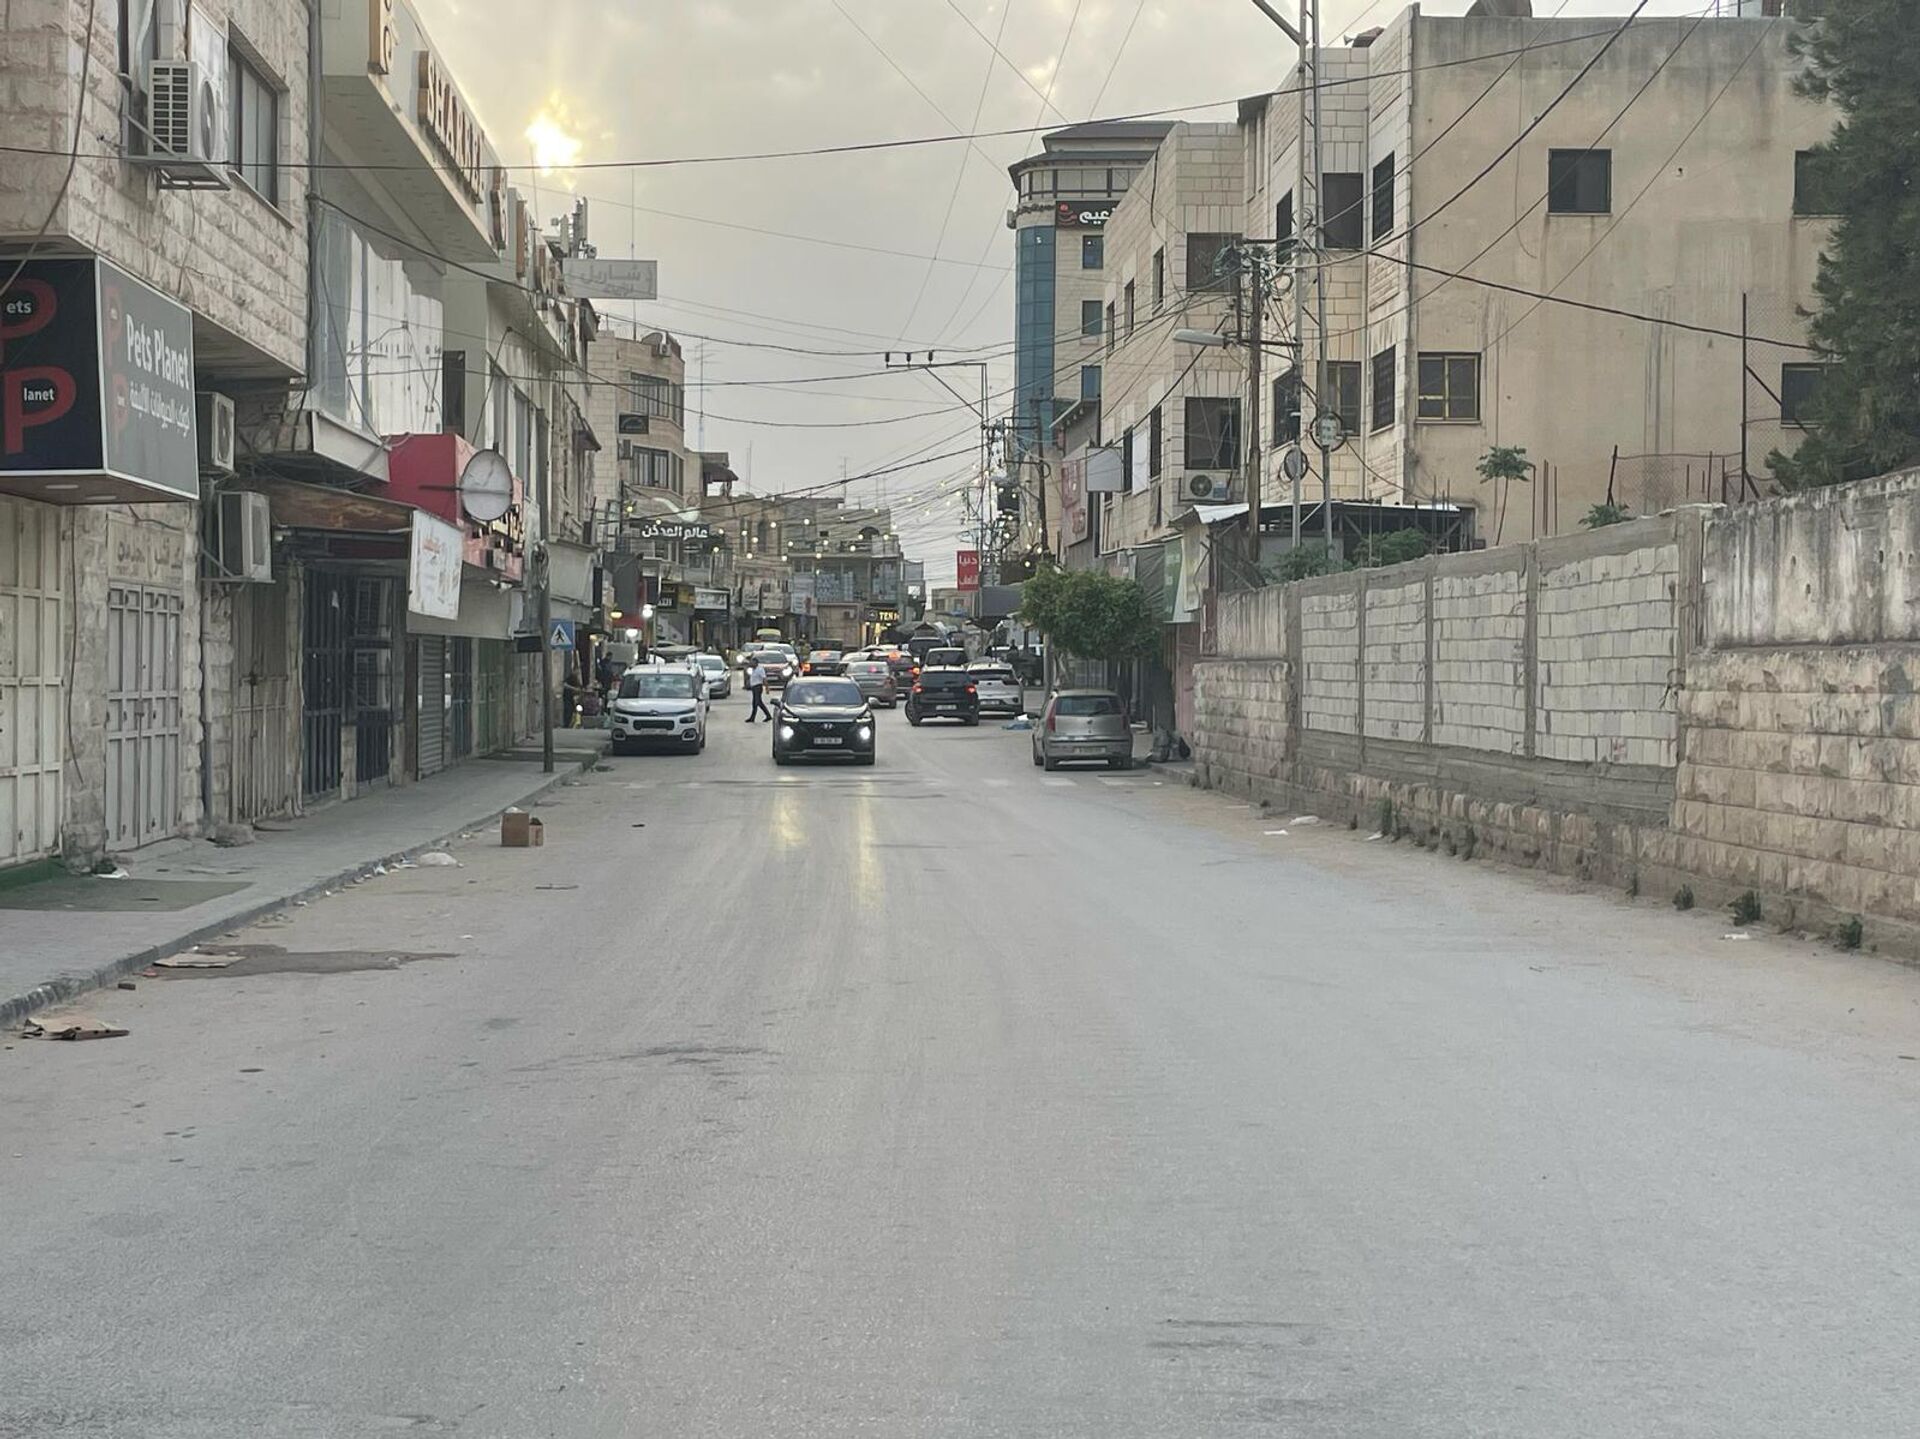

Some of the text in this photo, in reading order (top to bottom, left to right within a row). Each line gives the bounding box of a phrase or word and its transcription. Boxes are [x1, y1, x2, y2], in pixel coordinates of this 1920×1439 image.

[126, 313, 152, 373] Pets
[153, 328, 190, 391] Planet
[683, 526, 708, 541] عالم
